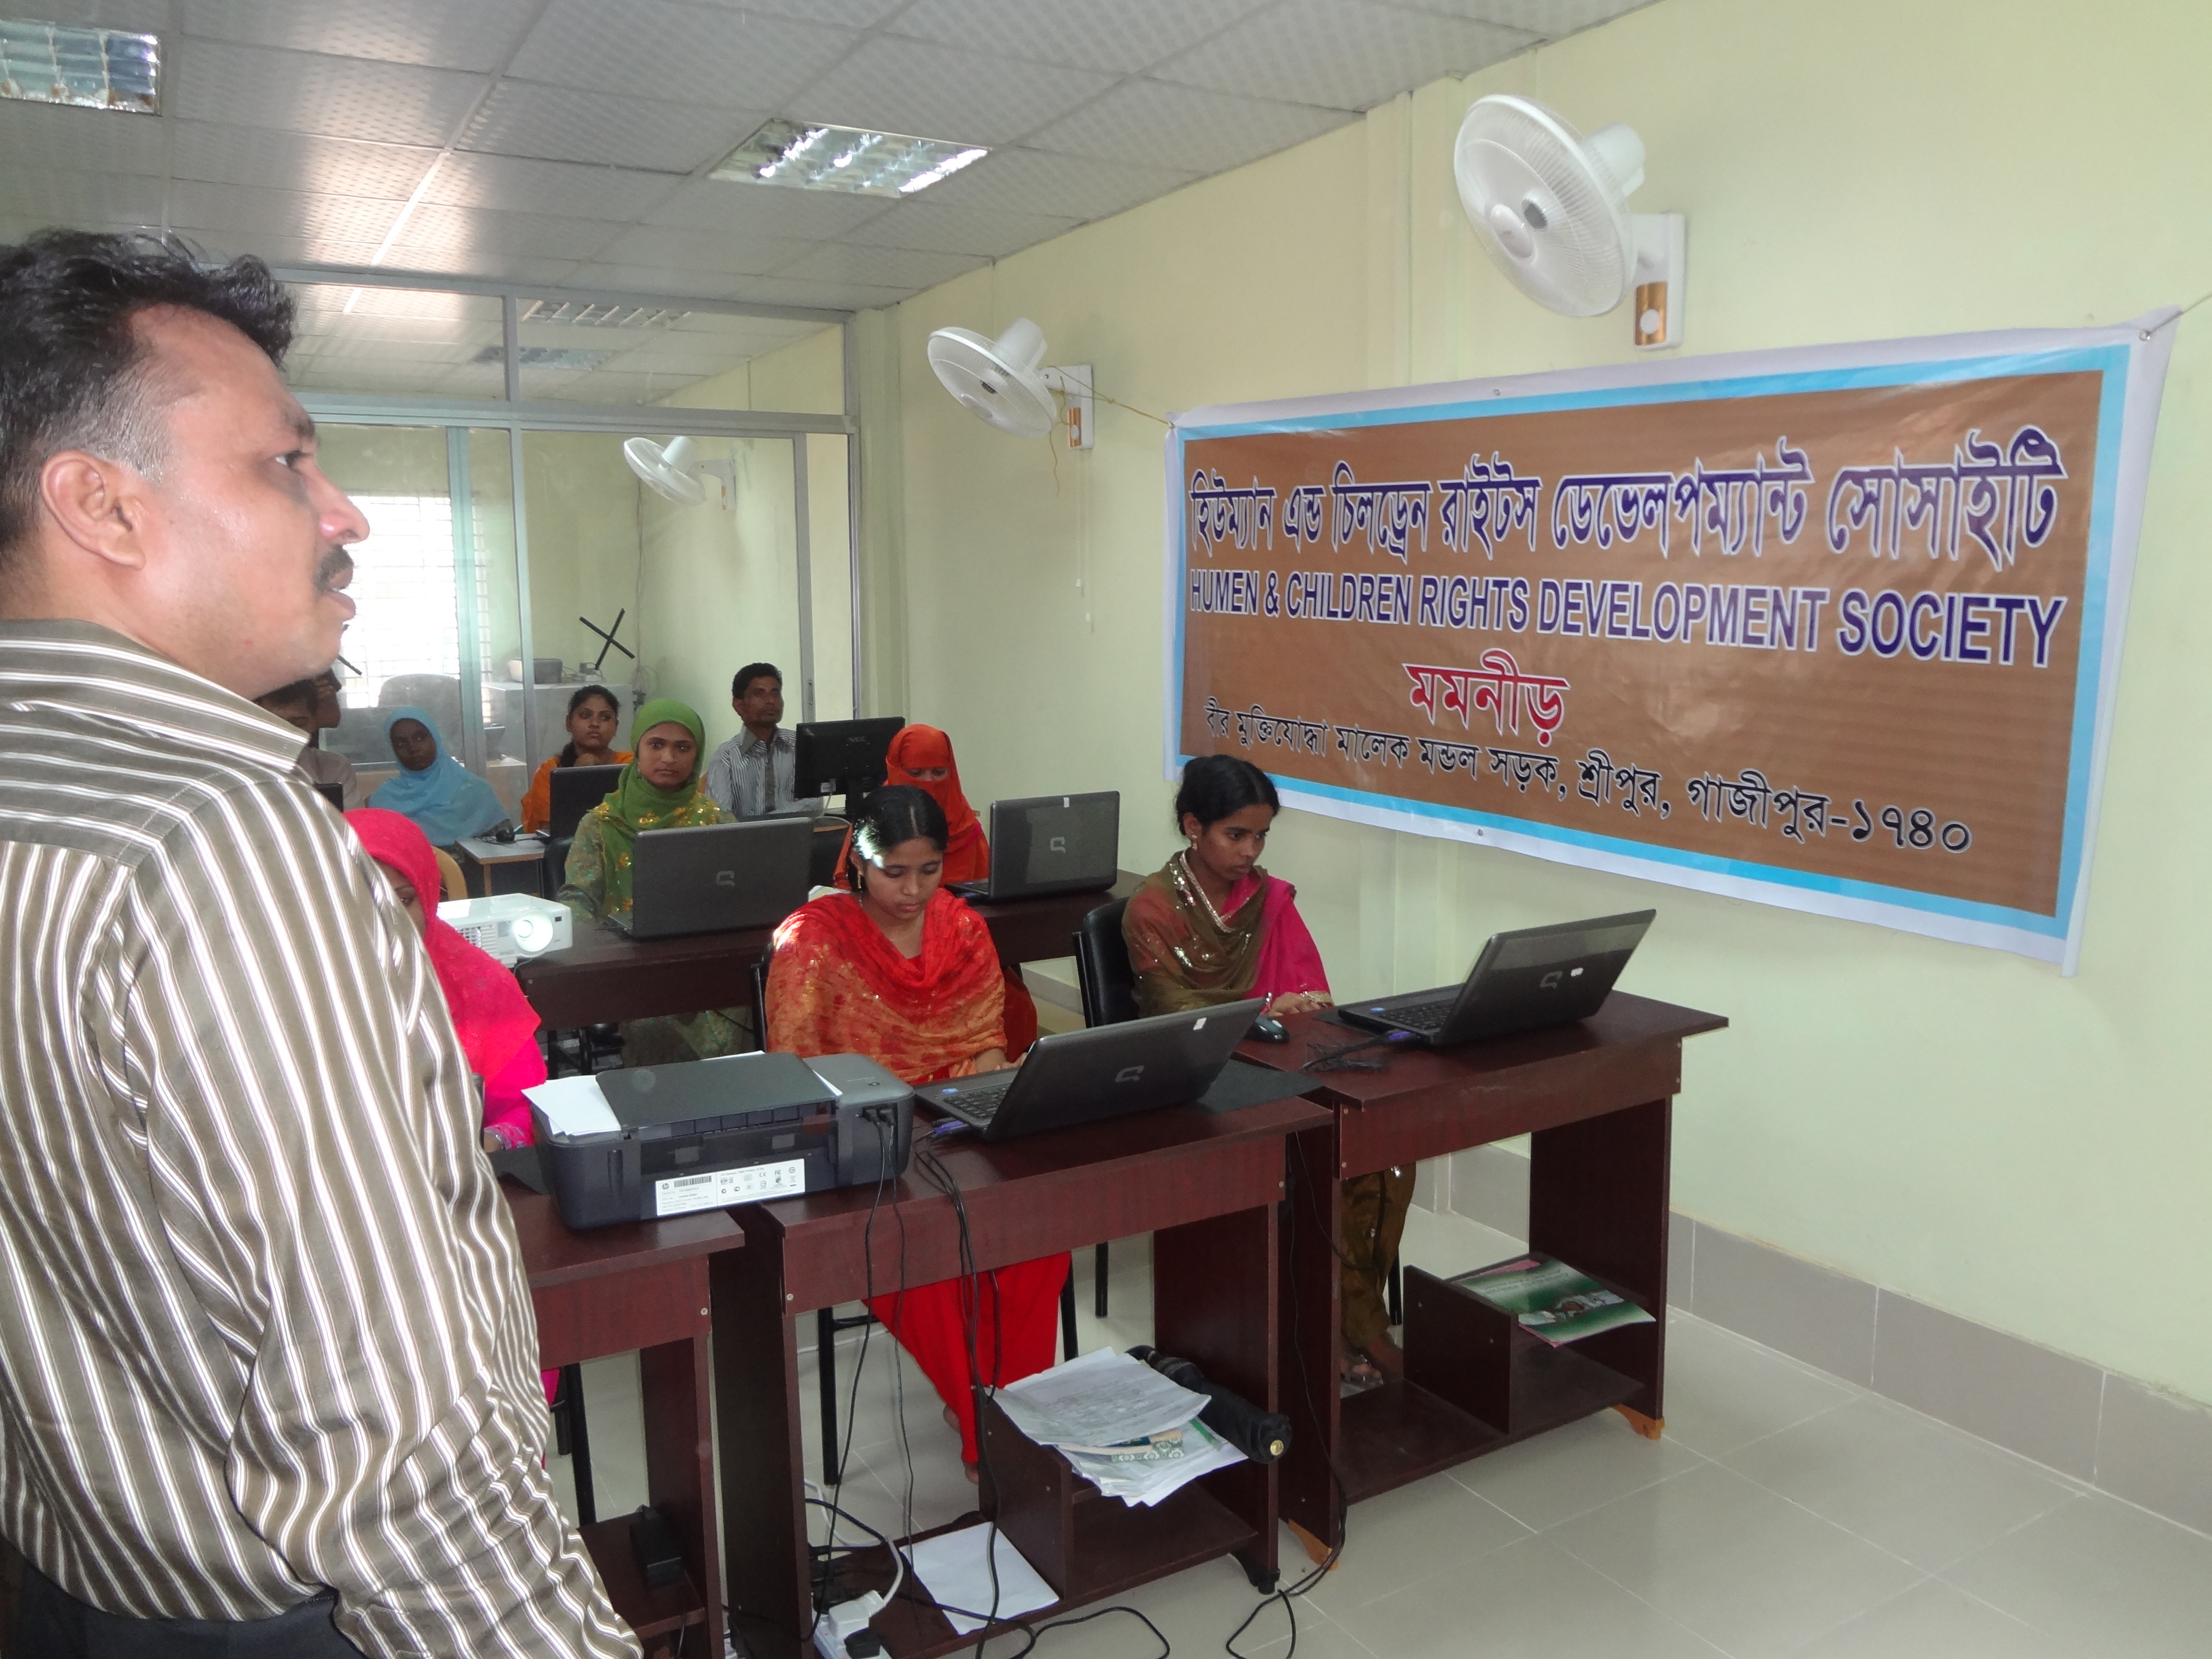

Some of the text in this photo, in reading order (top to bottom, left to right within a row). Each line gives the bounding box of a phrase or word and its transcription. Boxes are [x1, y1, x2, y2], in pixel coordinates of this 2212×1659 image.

[1189, 468, 1277, 558] হিউম্যান
[1329, 459, 1434, 566] চিলড্রেন
[1437, 451, 1543, 560] রাইটস
[1827, 425, 2068, 572] সোসাইটি
[1189, 568, 2068, 669] HUMEN & CHILDREN RIGHTS DEVELOPMENT SOCIETY
[1401, 648, 1572, 747] মমনীড়
[1203, 696, 1232, 739] বীর
[1233, 703, 1331, 757] মুক্তিযোদ্ধা
[1333, 723, 1411, 769] মালেক
[1486, 745, 1567, 802] সড়ক,
[1575, 747, 1671, 820] শ্রীপুর,
